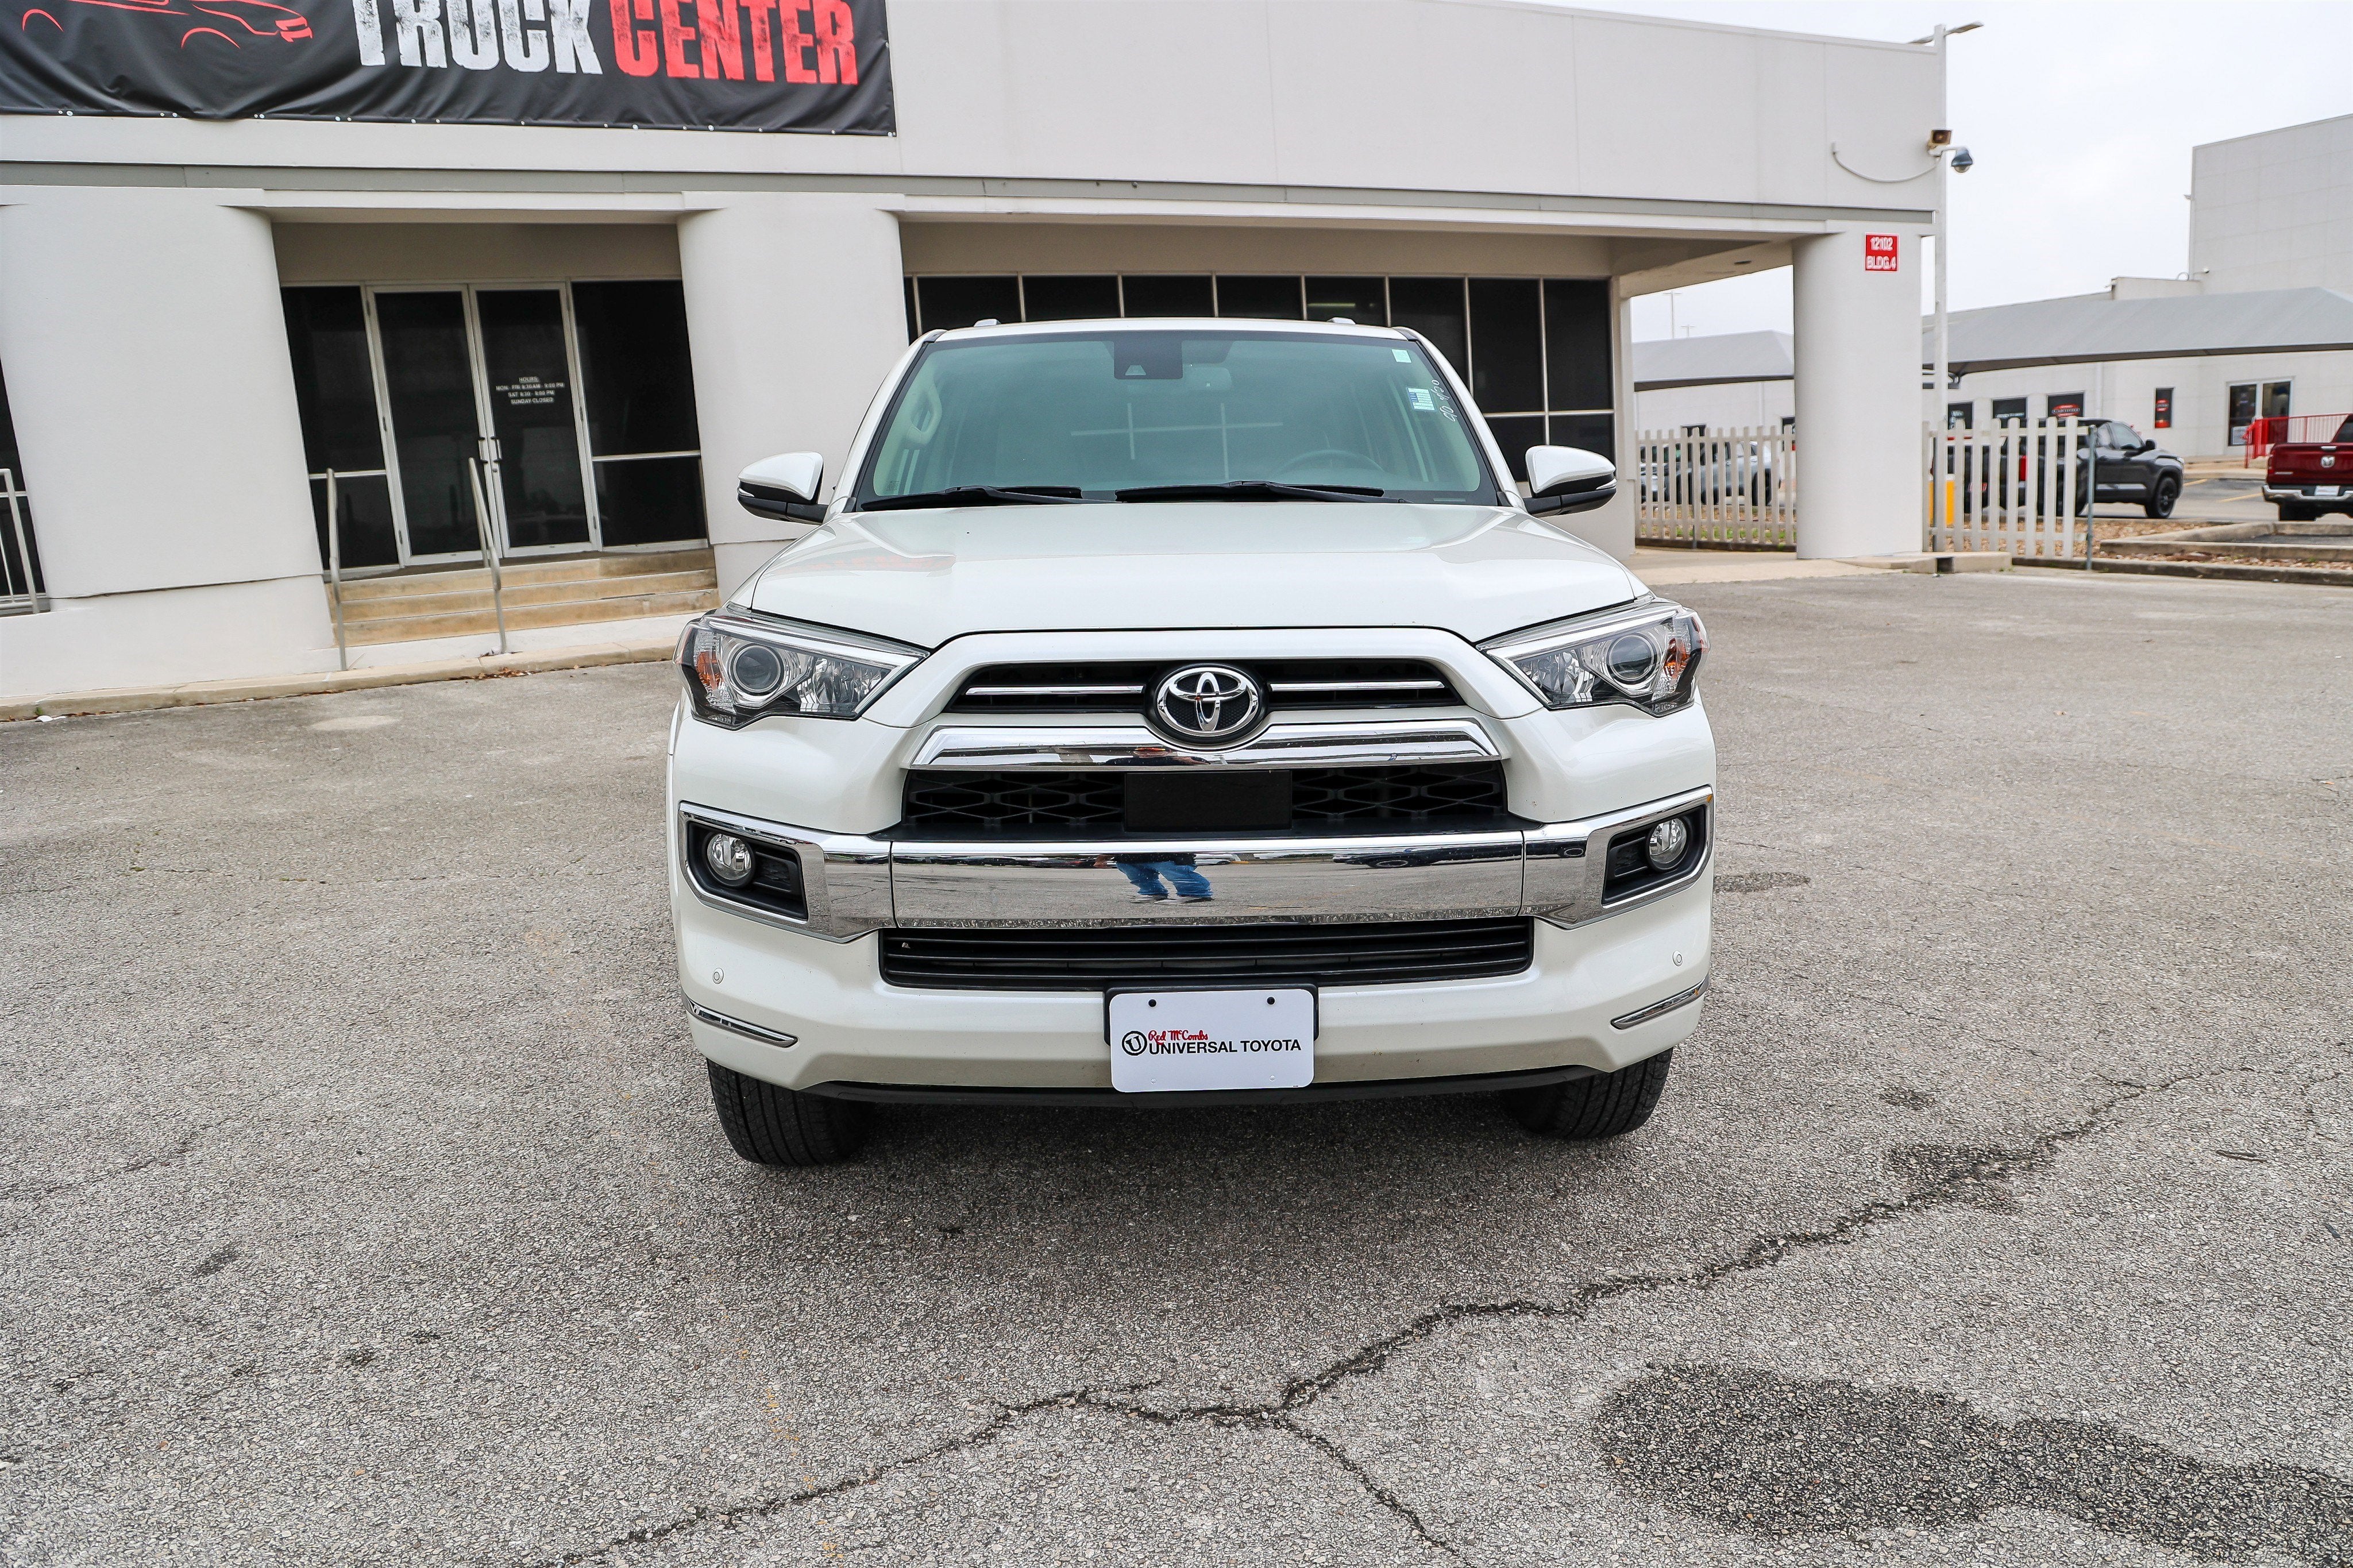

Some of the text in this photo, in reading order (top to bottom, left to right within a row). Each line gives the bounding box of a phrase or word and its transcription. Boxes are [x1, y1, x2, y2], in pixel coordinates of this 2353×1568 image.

[352, 0, 858, 85] TRUCK CENTER
[1870, 237, 1893, 251] 12102
[1148, 1030, 1208, 1045] Red McCombs
[1149, 1039, 1302, 1055] UNIVERSAL TOYOTA
